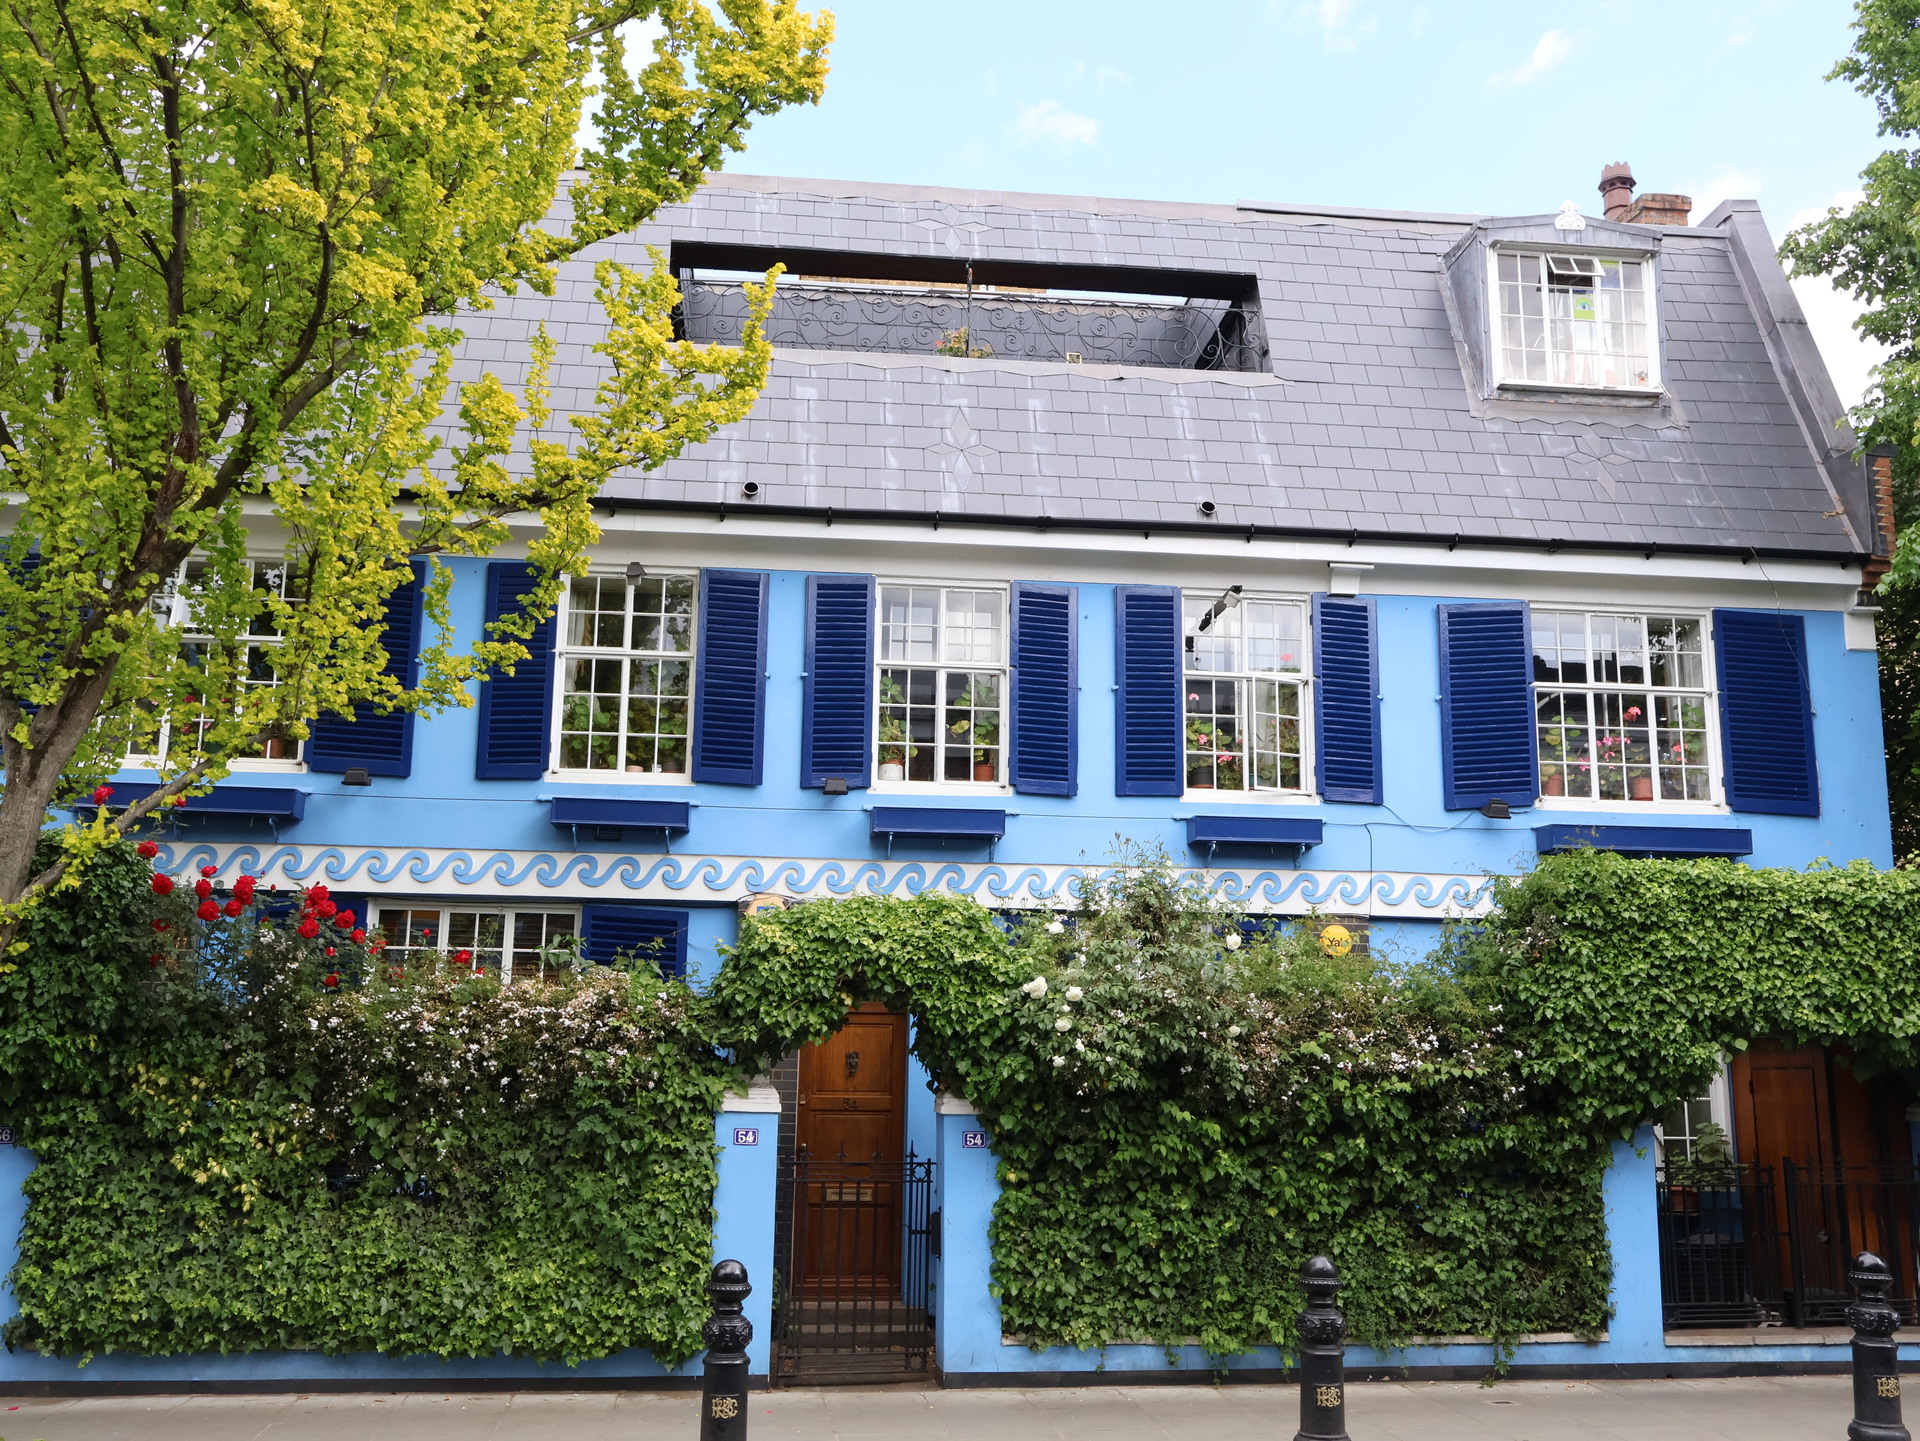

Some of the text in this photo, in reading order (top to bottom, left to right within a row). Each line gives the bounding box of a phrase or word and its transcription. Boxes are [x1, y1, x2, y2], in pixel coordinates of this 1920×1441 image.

[0, 1129, 10, 1141] 6
[738, 1131, 754, 1143] 54
[967, 1134, 982, 1146] 54
